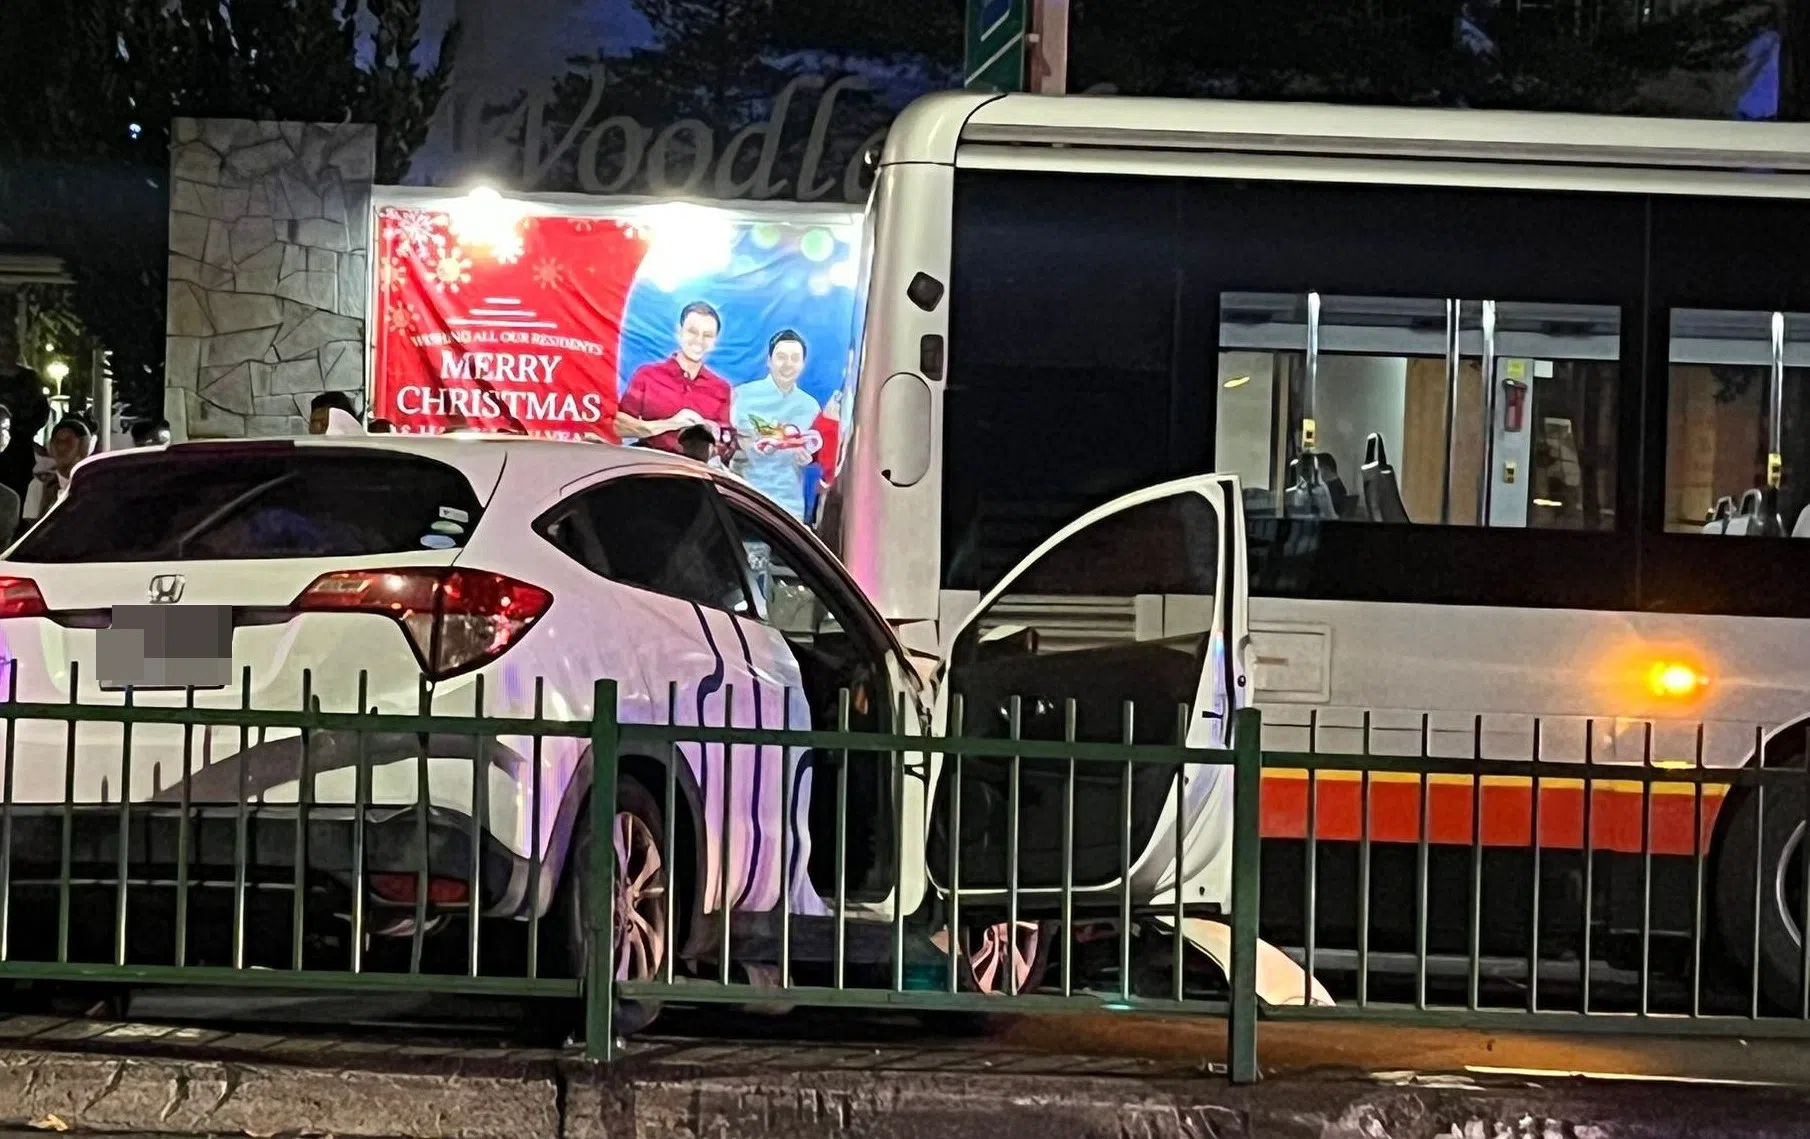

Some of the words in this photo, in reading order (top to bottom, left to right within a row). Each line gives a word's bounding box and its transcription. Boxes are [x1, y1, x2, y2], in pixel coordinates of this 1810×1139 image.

[473, 330, 498, 342] ALL
[500, 331, 530, 344] OUR
[440, 351, 562, 384] MERRY
[397, 387, 601, 423] CHRISTMAS
